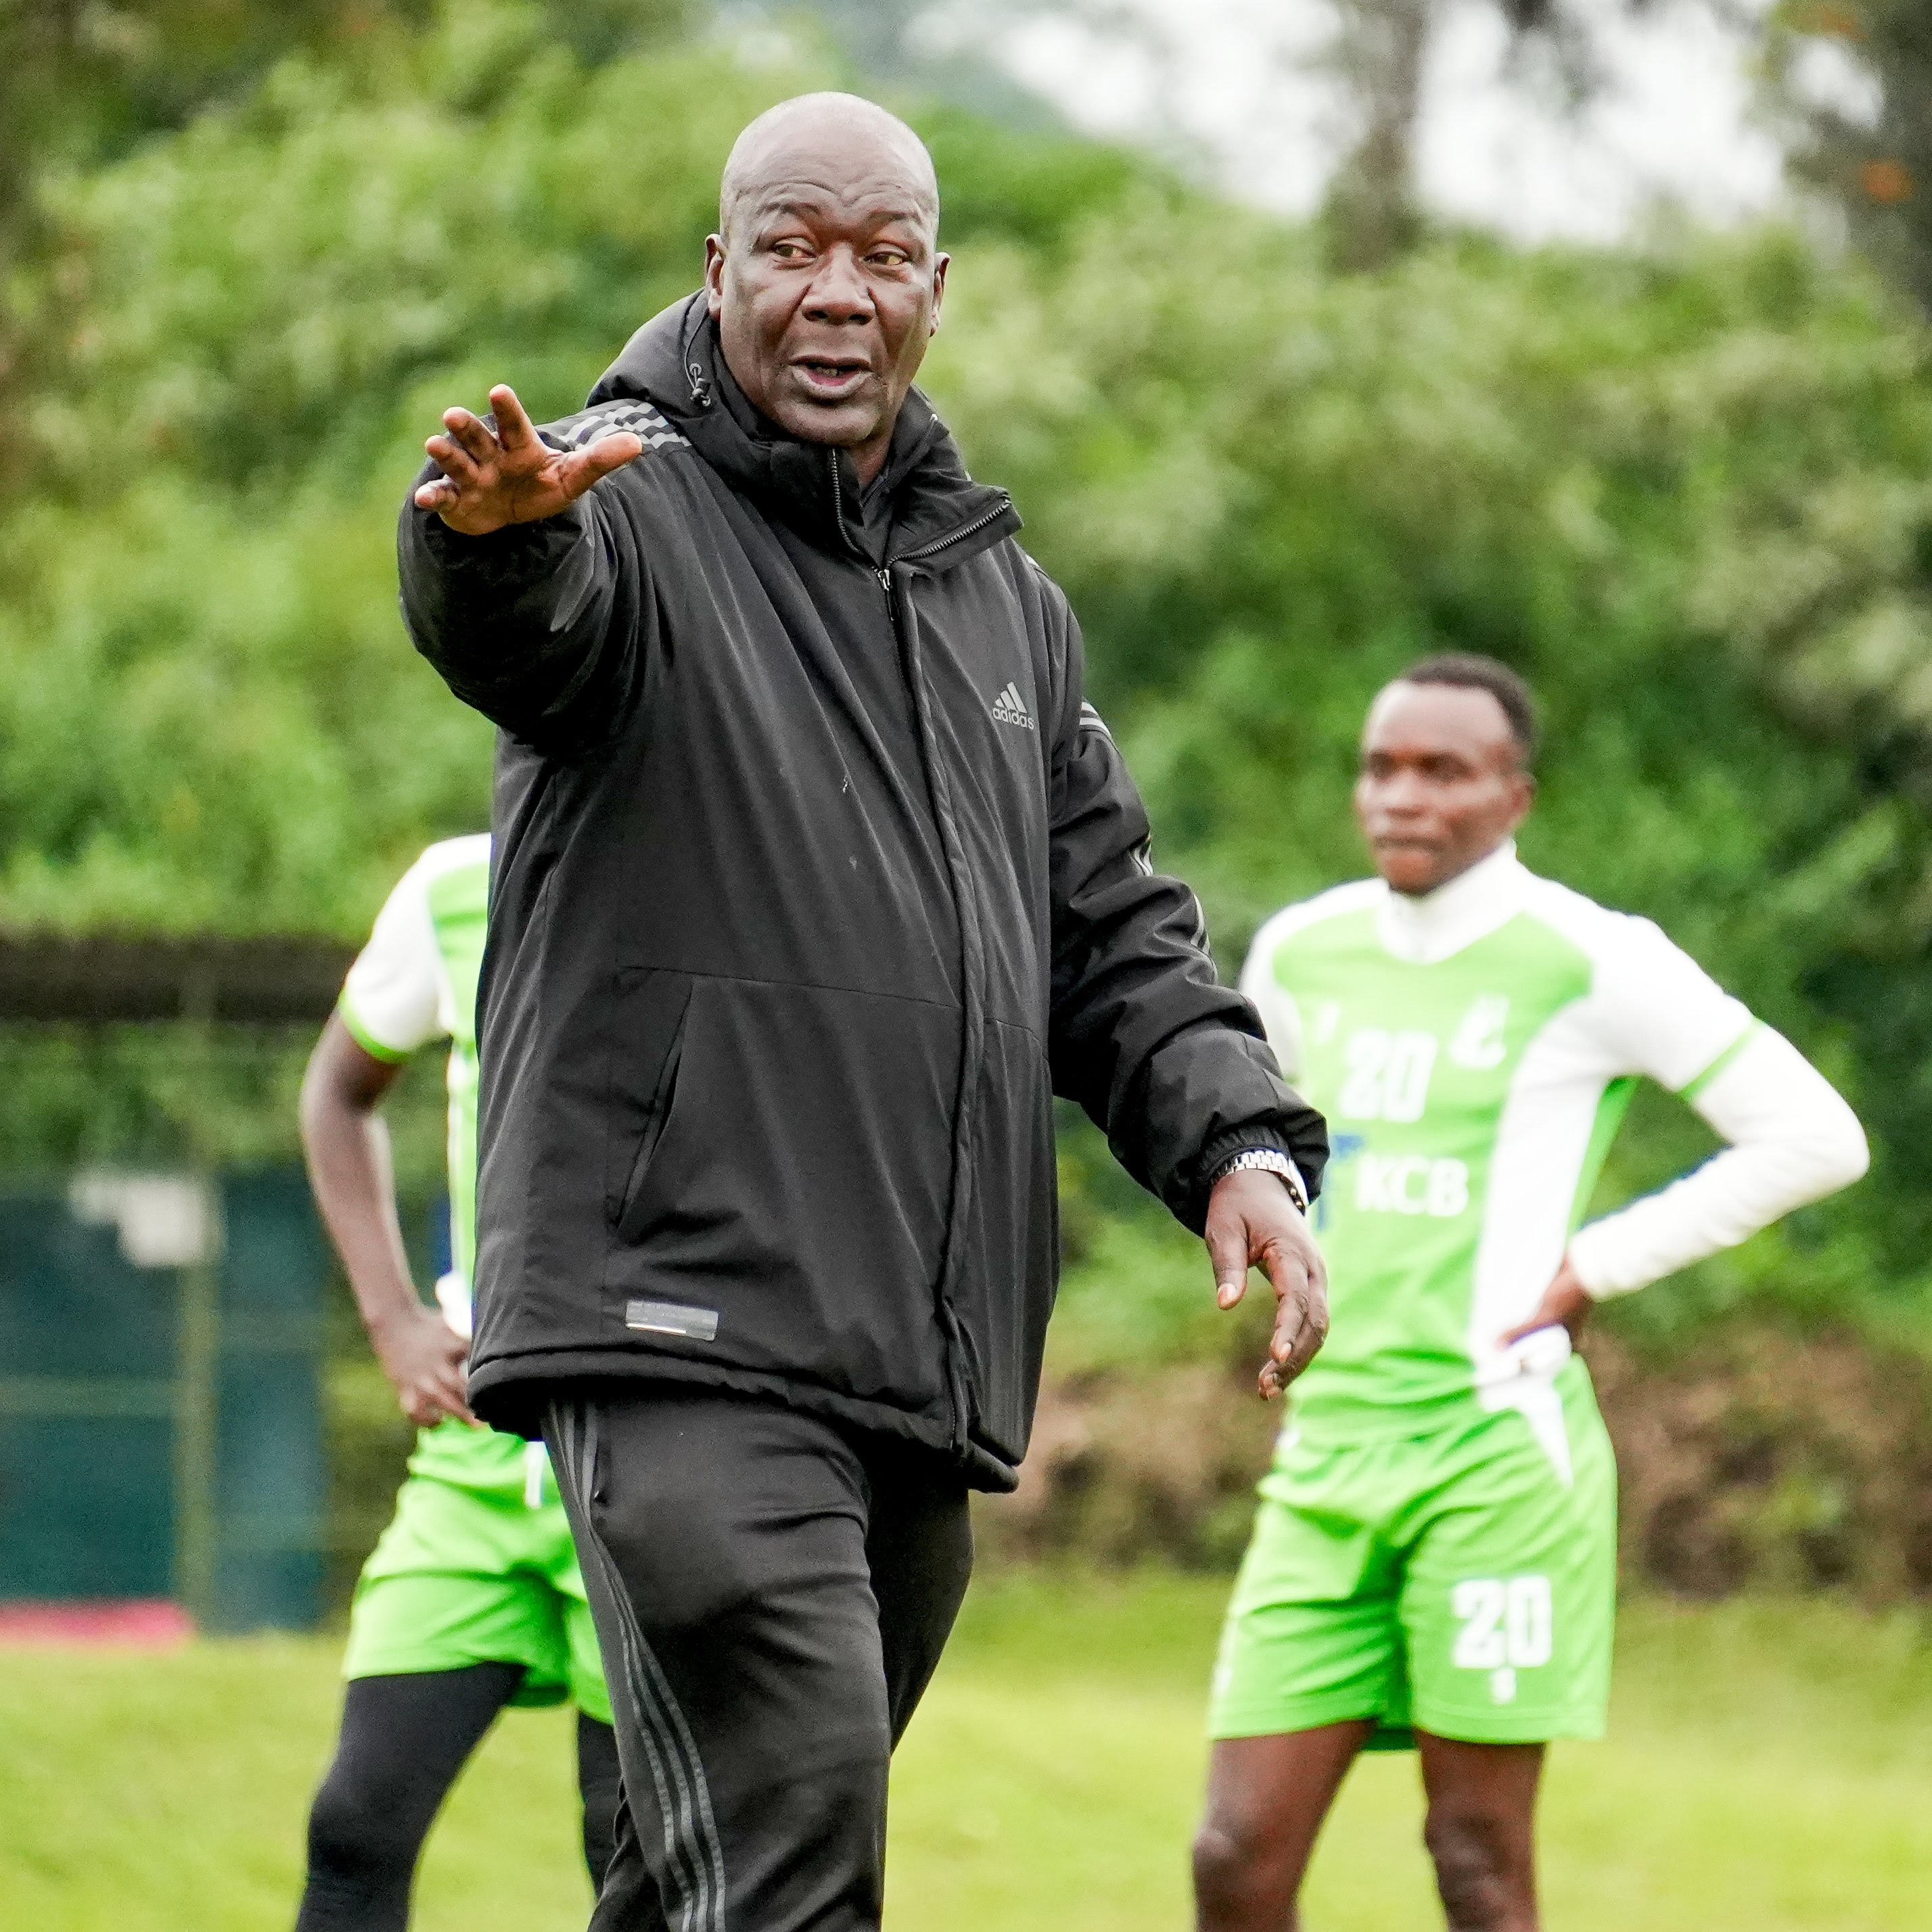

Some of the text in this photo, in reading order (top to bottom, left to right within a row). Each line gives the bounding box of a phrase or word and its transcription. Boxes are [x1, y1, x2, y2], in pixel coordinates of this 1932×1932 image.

[992, 706, 1035, 731] adidas
[1339, 1029, 1438, 1122] 20
[1356, 1155, 1469, 1216] KCB
[1451, 1576, 1551, 1668] 20
